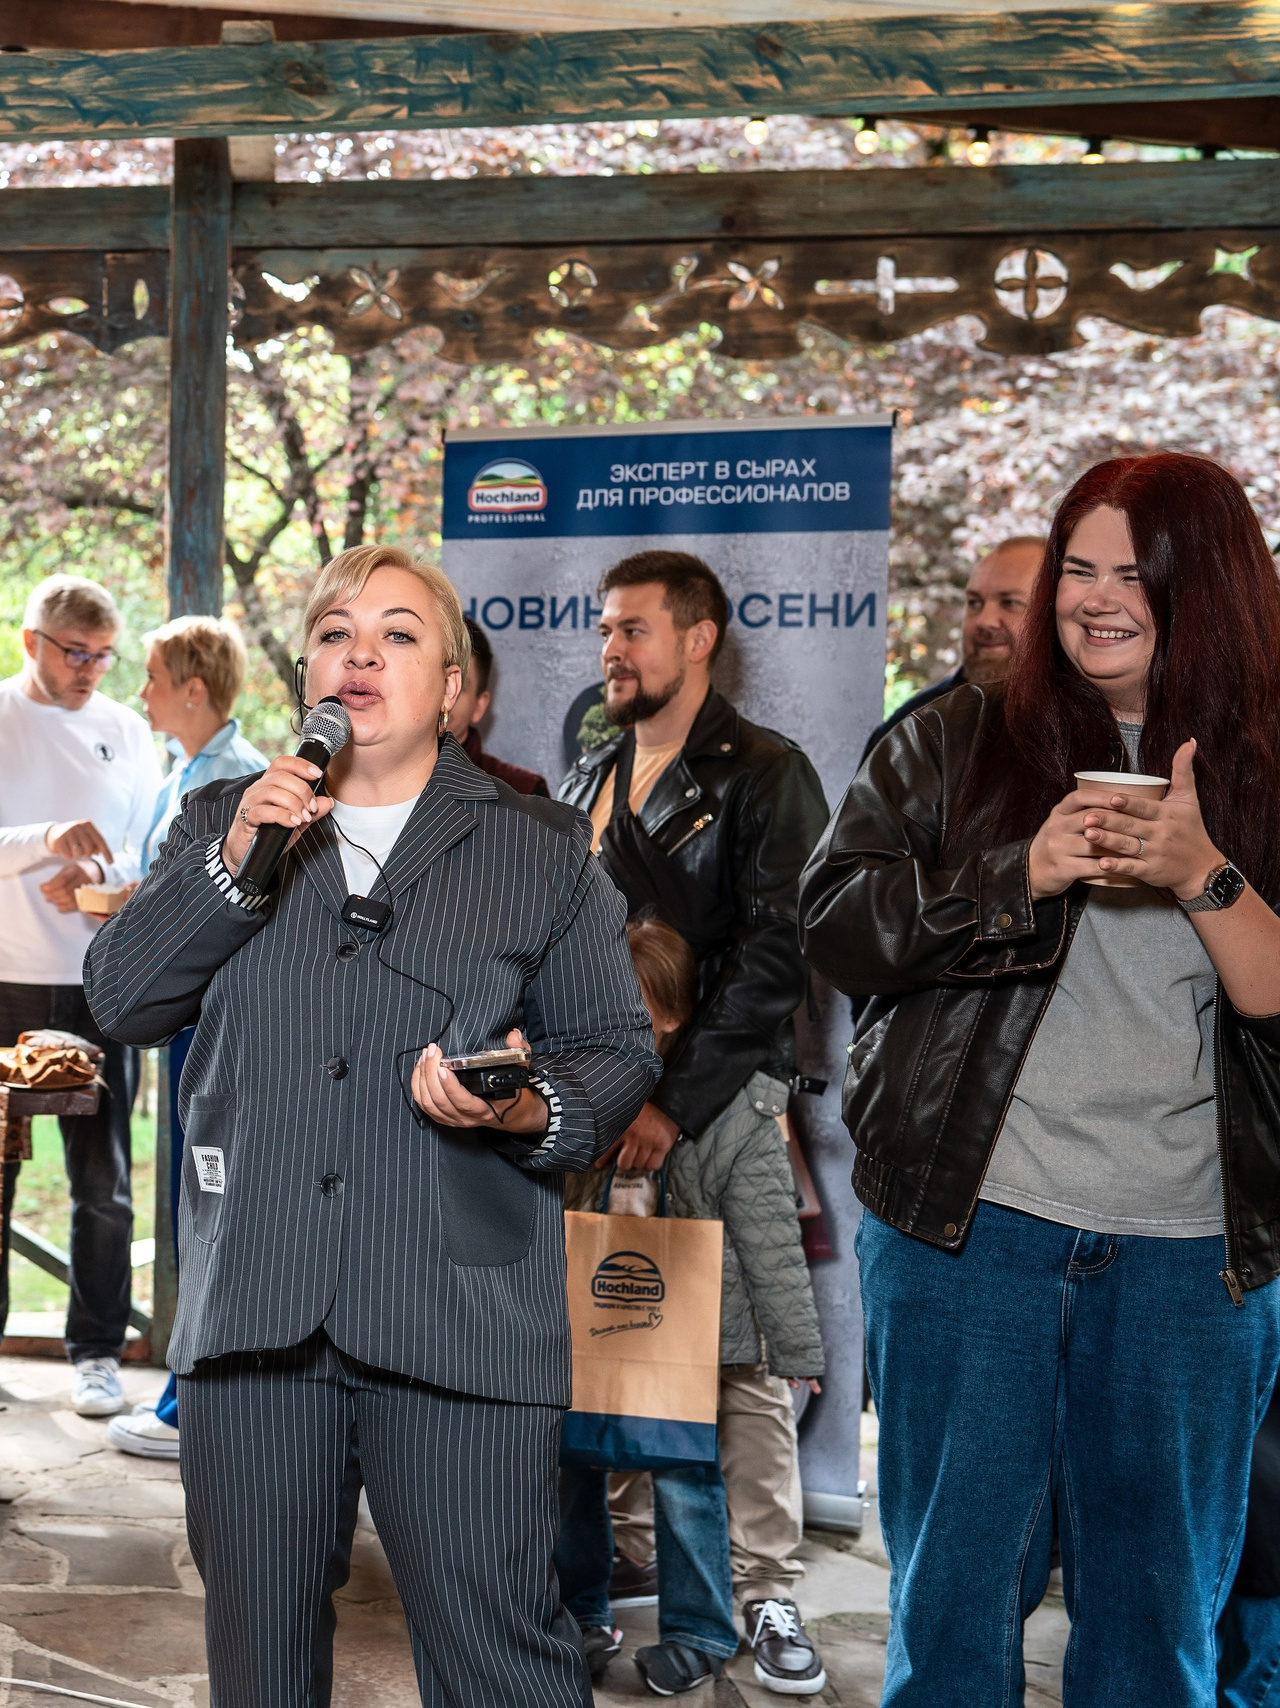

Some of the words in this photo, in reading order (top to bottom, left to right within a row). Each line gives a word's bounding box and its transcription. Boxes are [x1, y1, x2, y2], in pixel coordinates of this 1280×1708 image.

[609, 460, 709, 483] ЭКСПЕРТ
[714, 460, 730, 480] В
[736, 457, 817, 479] СЫРАХ
[475, 490, 540, 504] Hochland
[576, 488, 623, 511] ДЛЯ
[629, 481, 851, 506] ПРОФЕССИОНАЛОВ
[467, 512, 547, 524] PROFESSIONAL
[727, 592, 877, 629] СЕНИ
[201, 1154, 219, 1163] FASHION
[597, 1281, 659, 1295] Hochland
